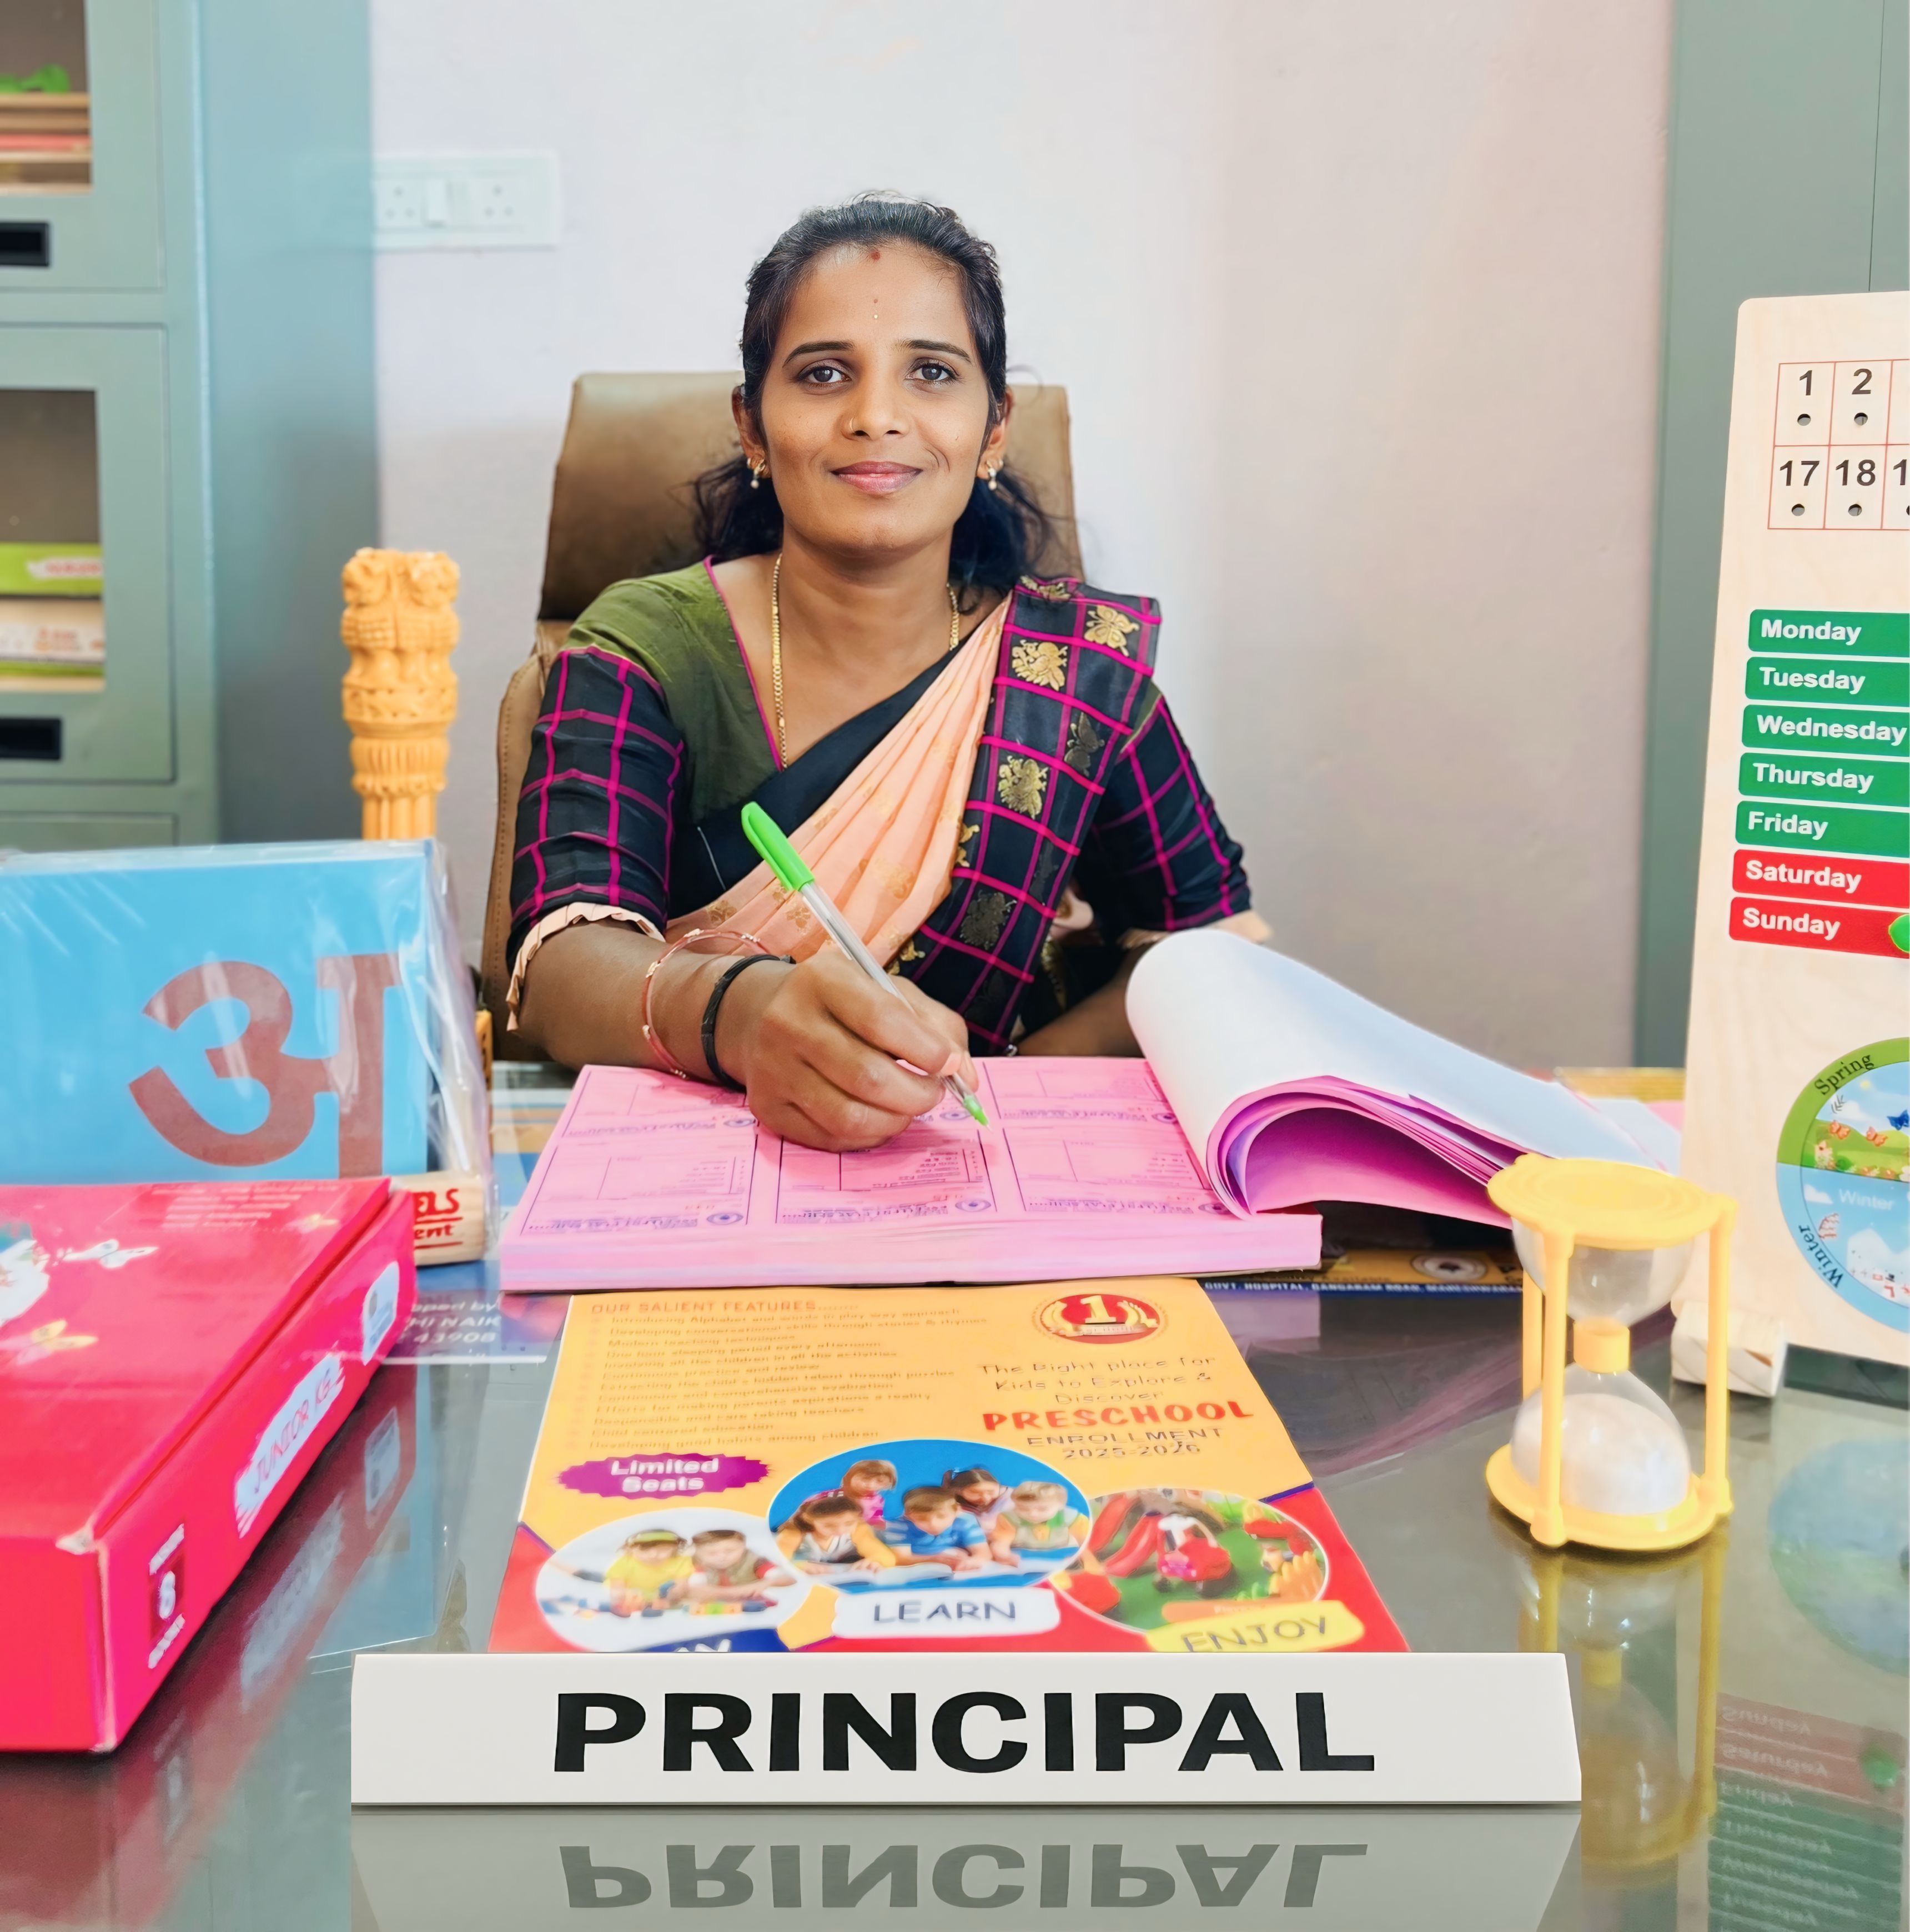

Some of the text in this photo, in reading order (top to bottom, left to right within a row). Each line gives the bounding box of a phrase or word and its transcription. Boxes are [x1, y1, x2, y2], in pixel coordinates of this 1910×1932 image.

[1799, 369, 1872, 396] 1 2
[1780, 459, 1908, 486] 17 18 1
[1761, 619, 1862, 646] Monday
[1758, 667, 1866, 695] Tuesday
[1757, 715, 1907, 746] Wednesday
[1752, 762, 1874, 794] Thursday
[1748, 811, 1828, 841] Friday
[1746, 860, 1862, 894] Saturday
[1743, 908, 1841, 940] Sunday
[128, 952, 403, 1179] अ
[1814, 1054, 1875, 1096] Spring
[1839, 1189, 1894, 1211] Winter
[414, 1224, 454, 1240] ent
[1798, 1225, 1843, 1289] Winter
[592, 1302, 630, 1314] OUR
[639, 1301, 716, 1313] SALIENT
[977, 1362, 1023, 1376] The
[1107, 1357, 1169, 1373] place
[1179, 1355, 1215, 1368] for
[996, 1378, 1046, 1392] Kids
[1059, 1377, 1081, 1389] to
[1090, 1373, 1187, 1389] Explore
[1055, 1391, 1164, 1405] Discover
[982, 1401, 1255, 1431] PRESCHOOL
[1027, 1428, 1223, 1446] ENROLLMENT
[1063, 1441, 1202, 1461] 2025-2026
[611, 1458, 719, 1475] Limited
[621, 1476, 705, 1493] Seats
[874, 1600, 1017, 1623] LEARN
[1180, 1615, 1326, 1652] ENJOY
[554, 1691, 1375, 1773] PRINCIPAL
